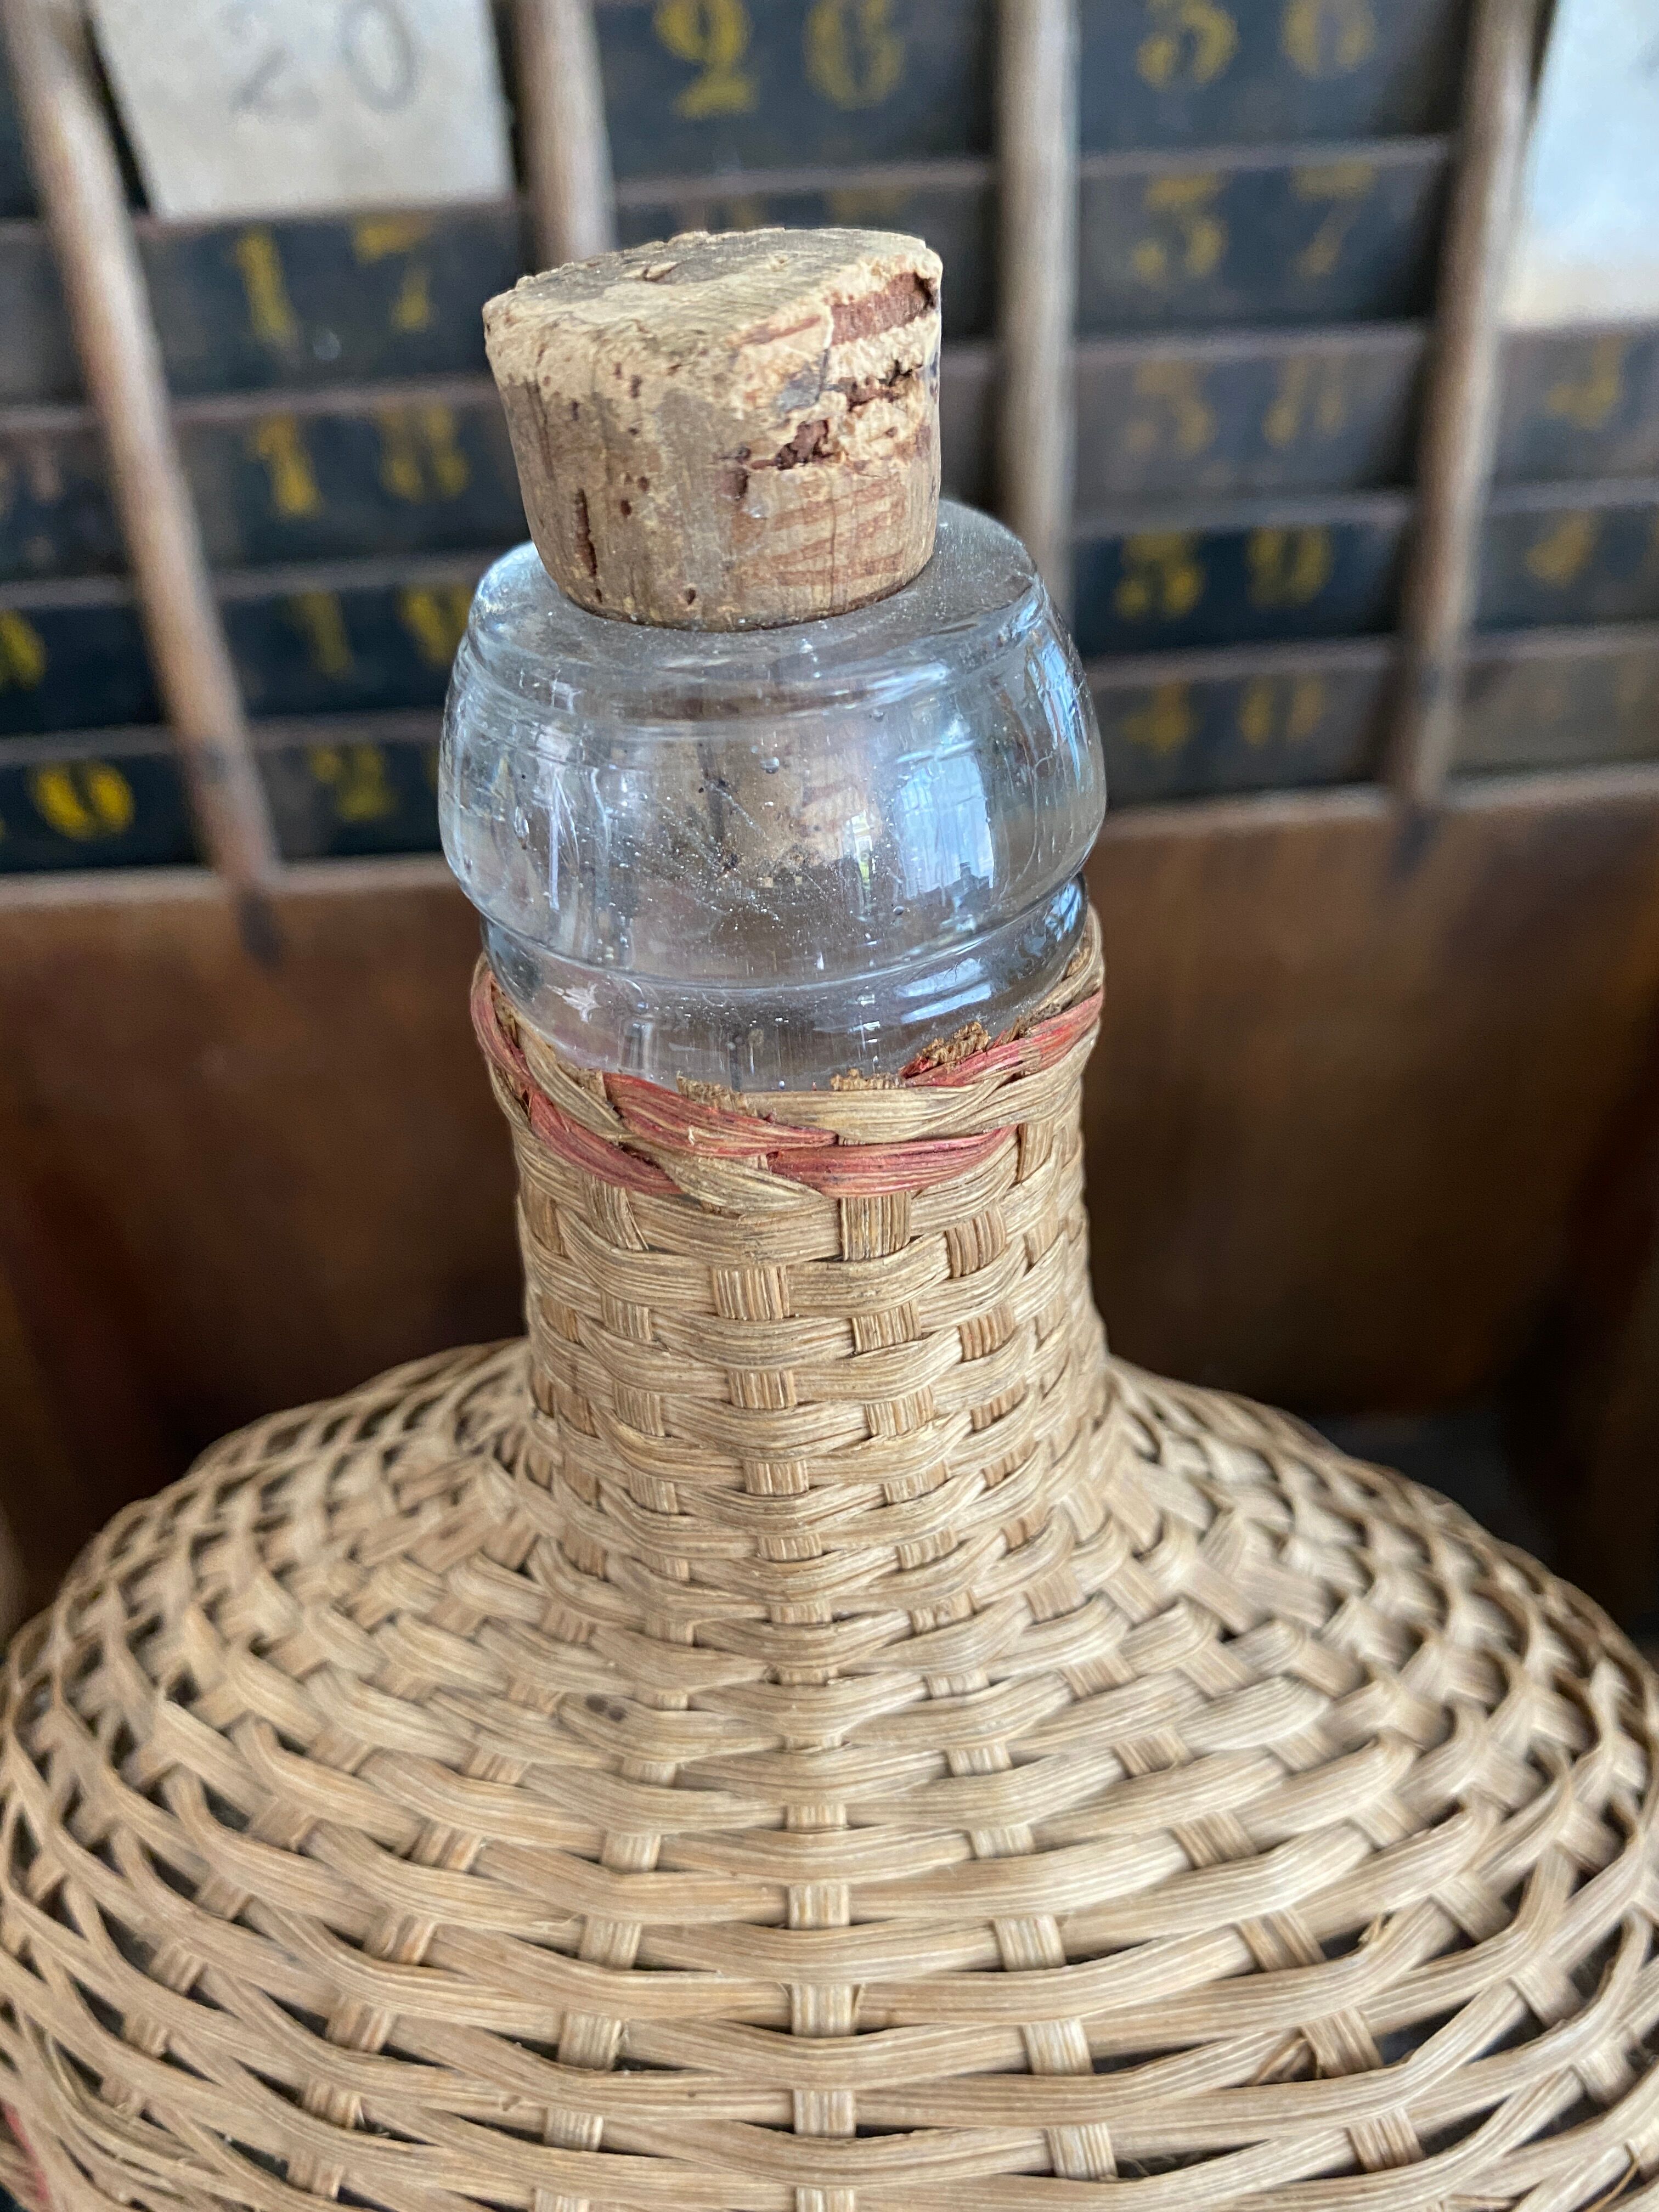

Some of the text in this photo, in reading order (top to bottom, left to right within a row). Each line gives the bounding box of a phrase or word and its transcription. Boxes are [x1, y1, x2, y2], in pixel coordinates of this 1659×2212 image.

[654, 0, 908, 120] 26
[233, 217, 433, 340] 17
[1130, 165, 1380, 283] 37
[0, 756, 137, 842] 0
